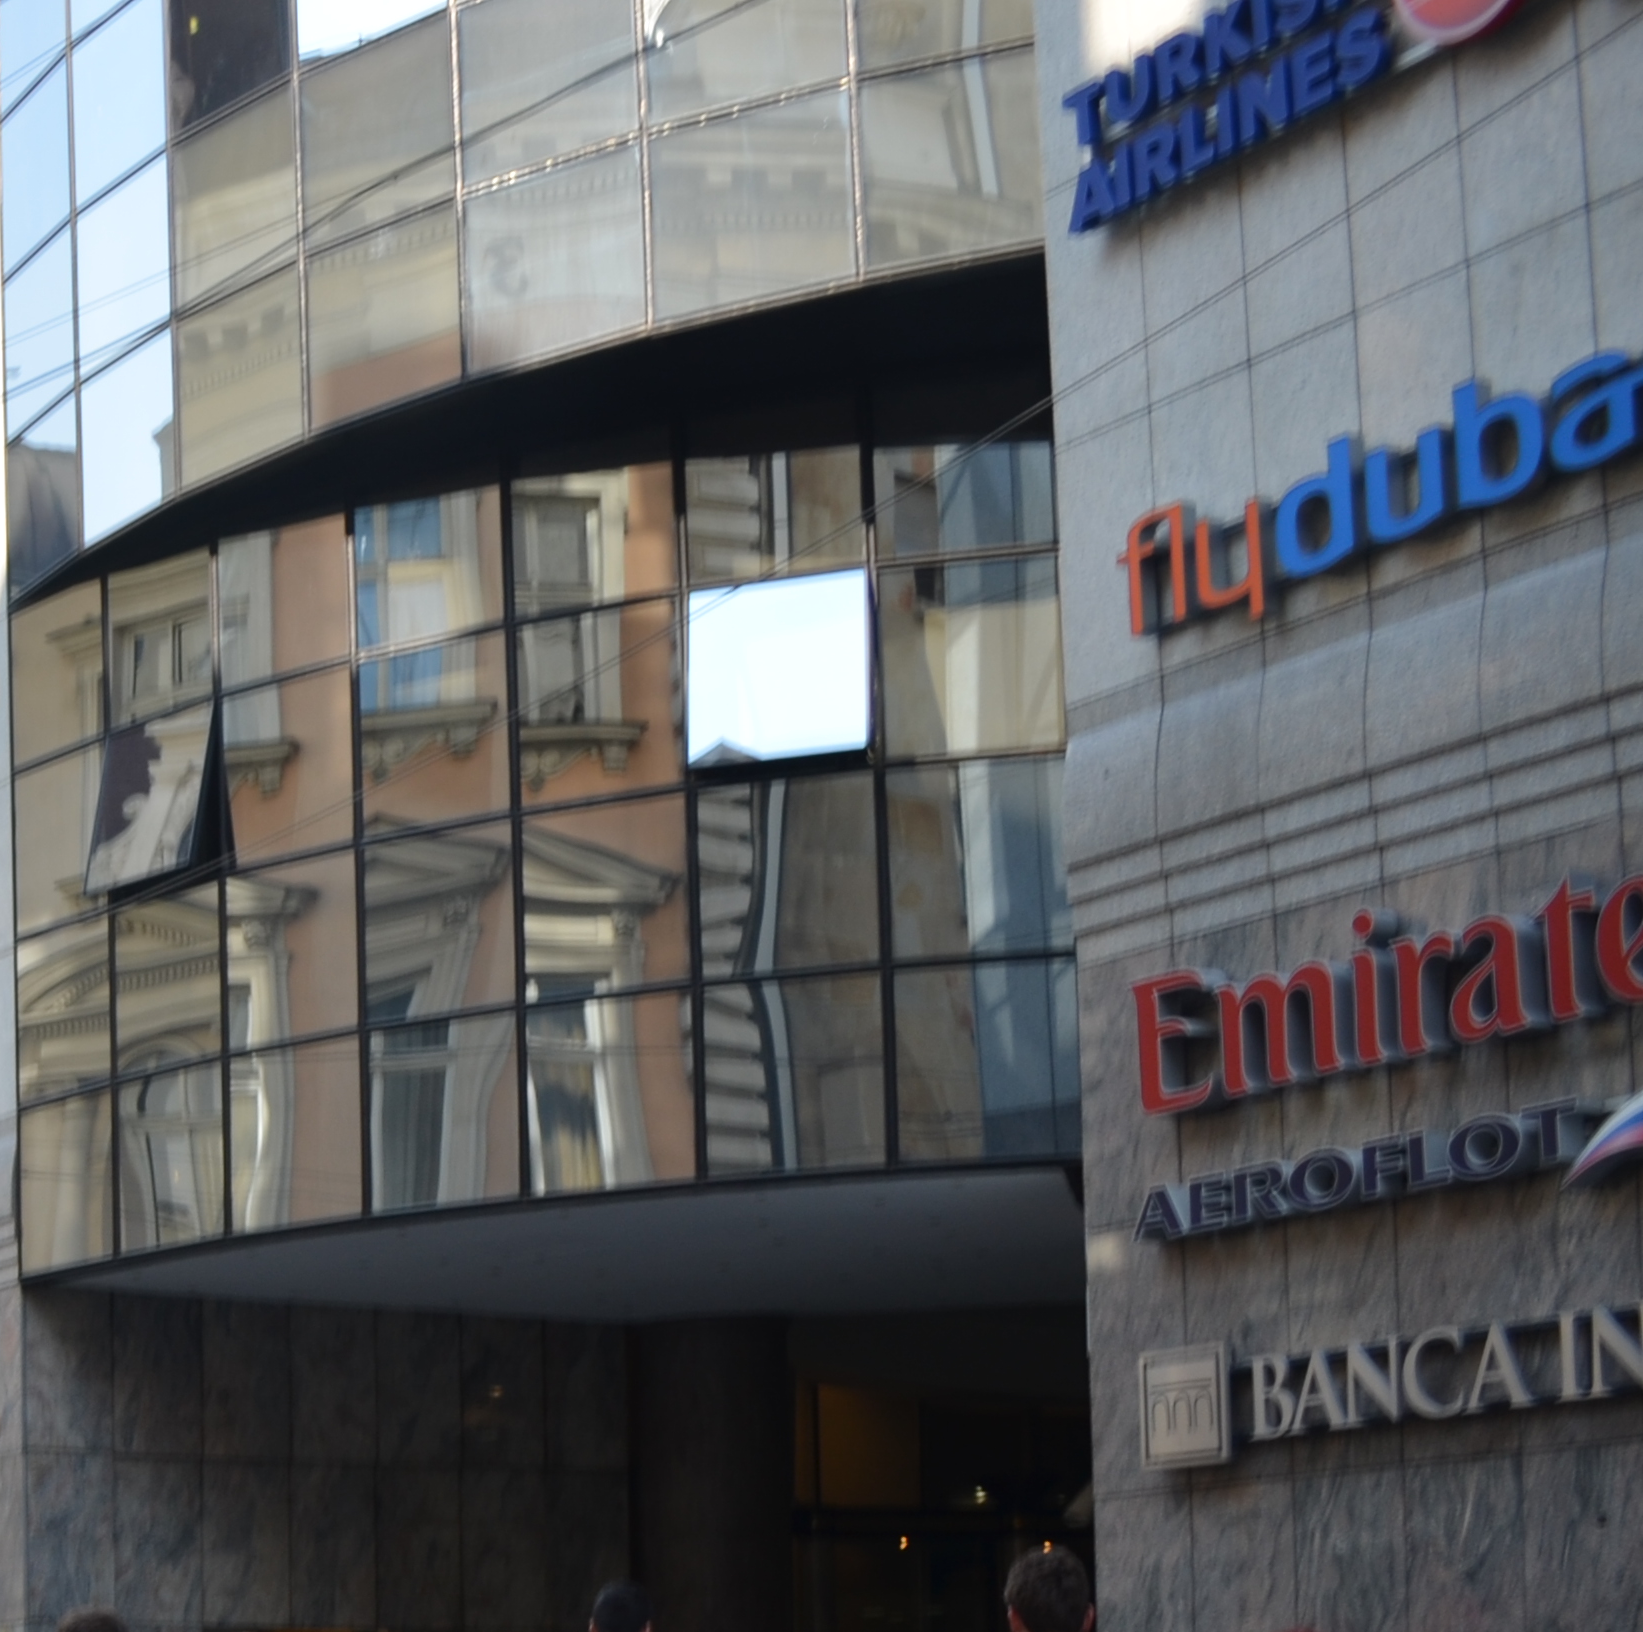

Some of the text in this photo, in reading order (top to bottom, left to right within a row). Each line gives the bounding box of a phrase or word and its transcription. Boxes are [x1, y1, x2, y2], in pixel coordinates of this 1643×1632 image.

[1063, 0, 1343, 146] TURKIS
[1068, 8, 1391, 234] AIRLINES
[1133, 1098, 1575, 1242] AEROFLOT
[1250, 1320, 1538, 1442] BANCA
